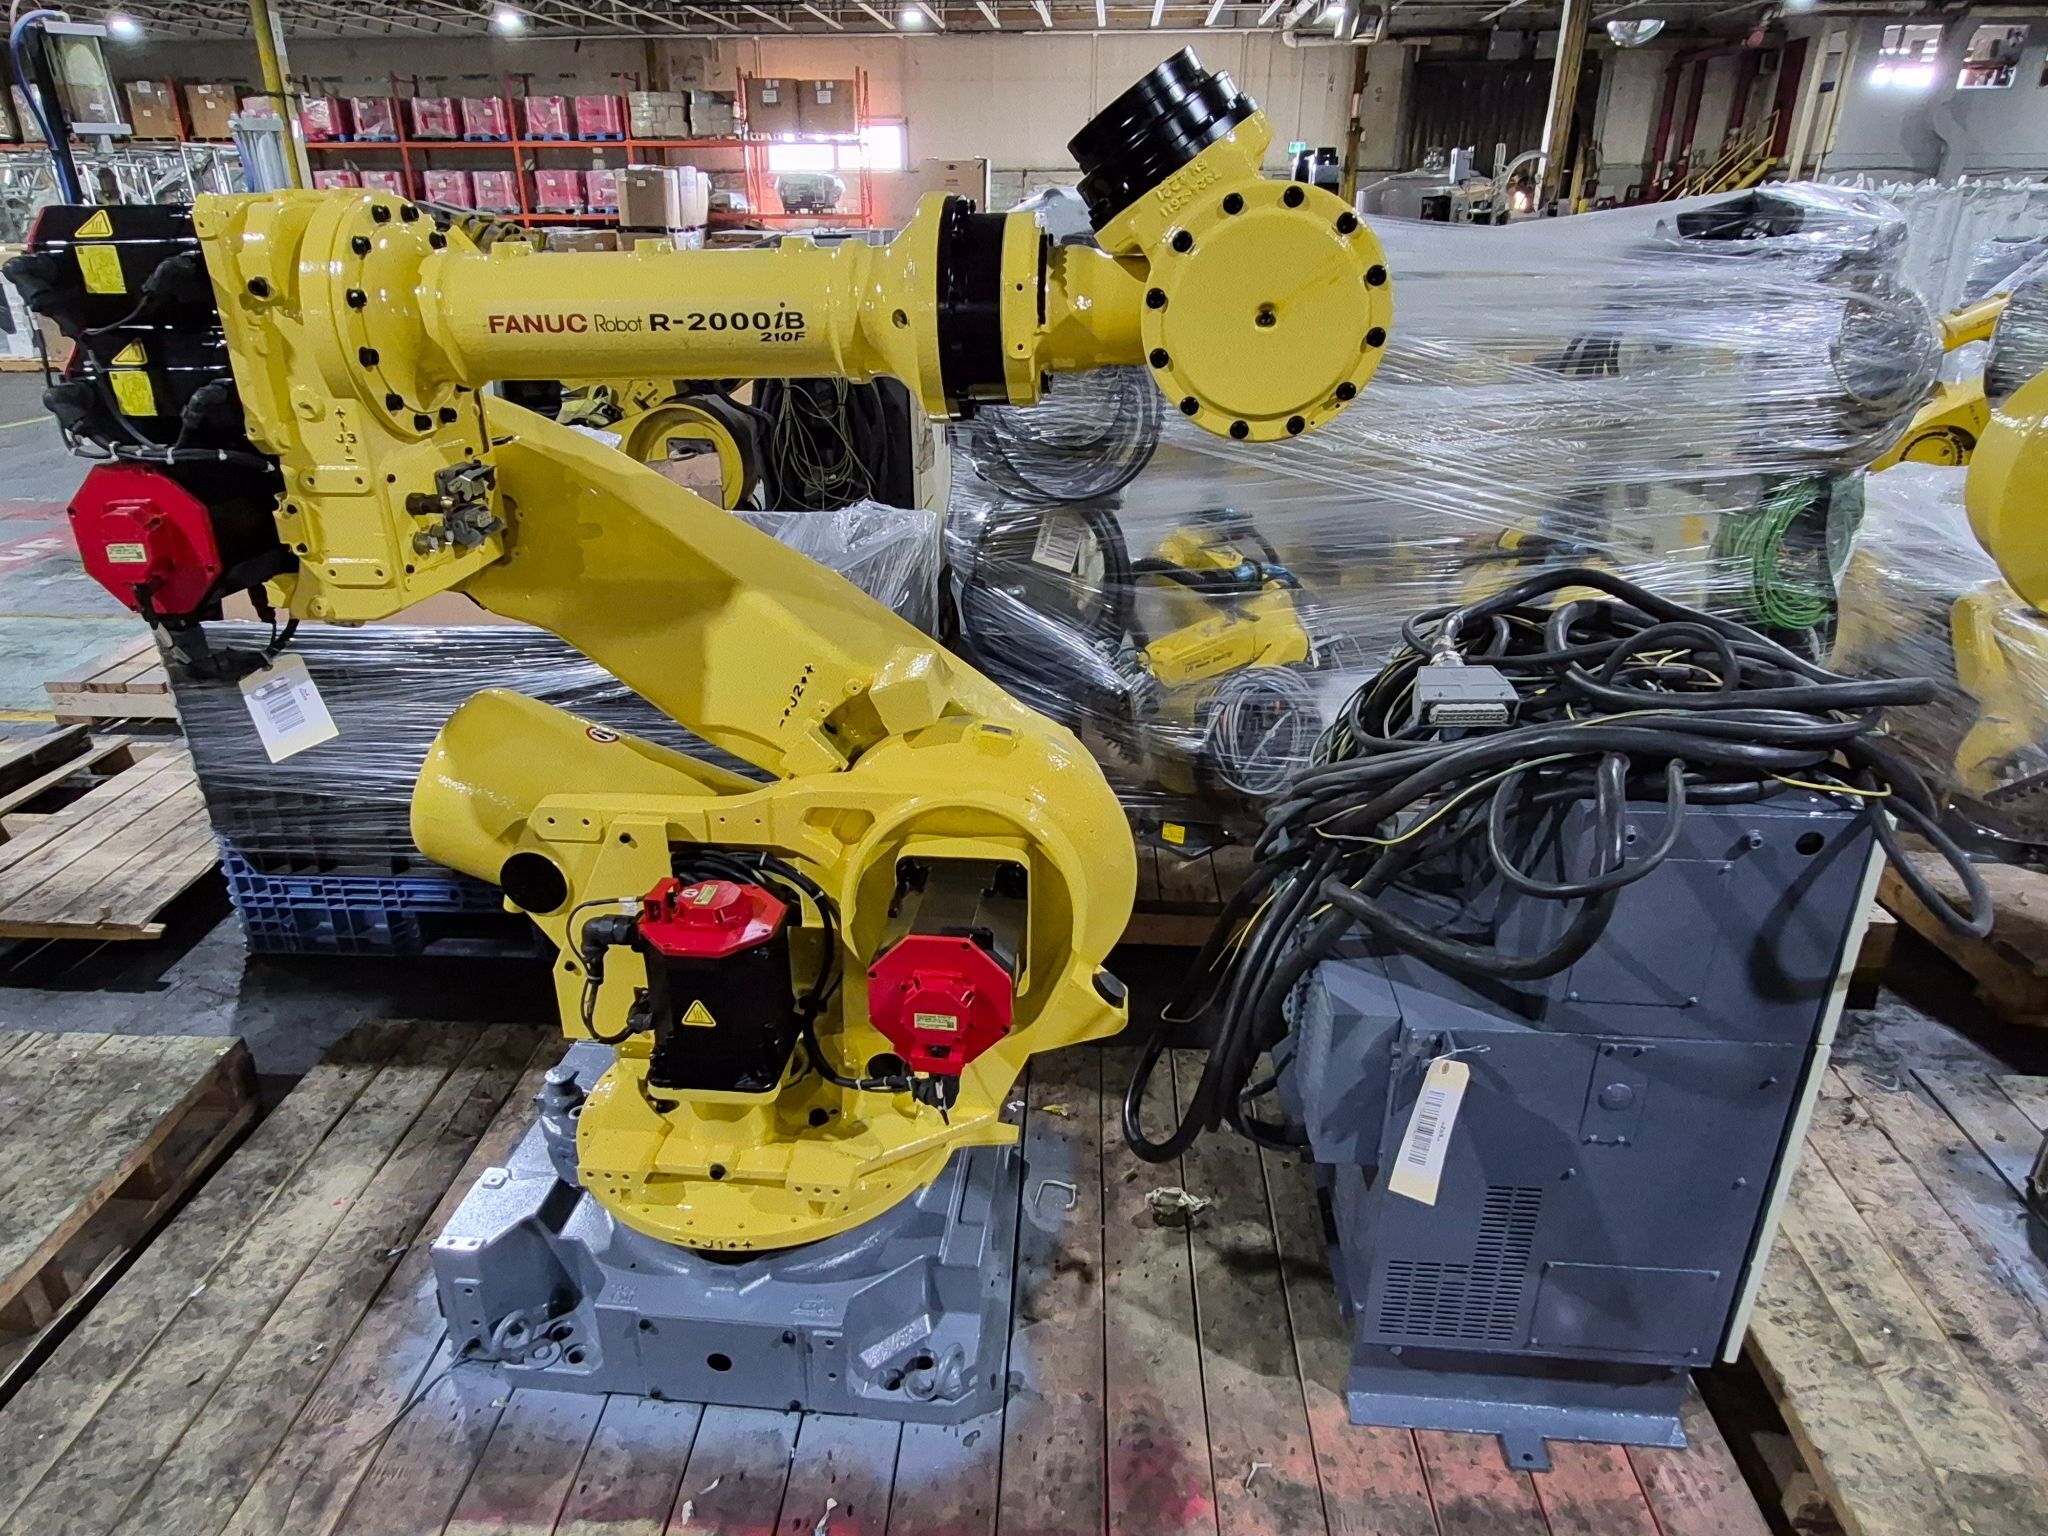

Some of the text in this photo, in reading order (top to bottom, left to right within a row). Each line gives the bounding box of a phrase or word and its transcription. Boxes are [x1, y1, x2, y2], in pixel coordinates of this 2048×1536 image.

[488, 301, 806, 334] FANUC Robot R-2000iB
[760, 331, 806, 342] 210F
[789, 683, 805, 708] J2
